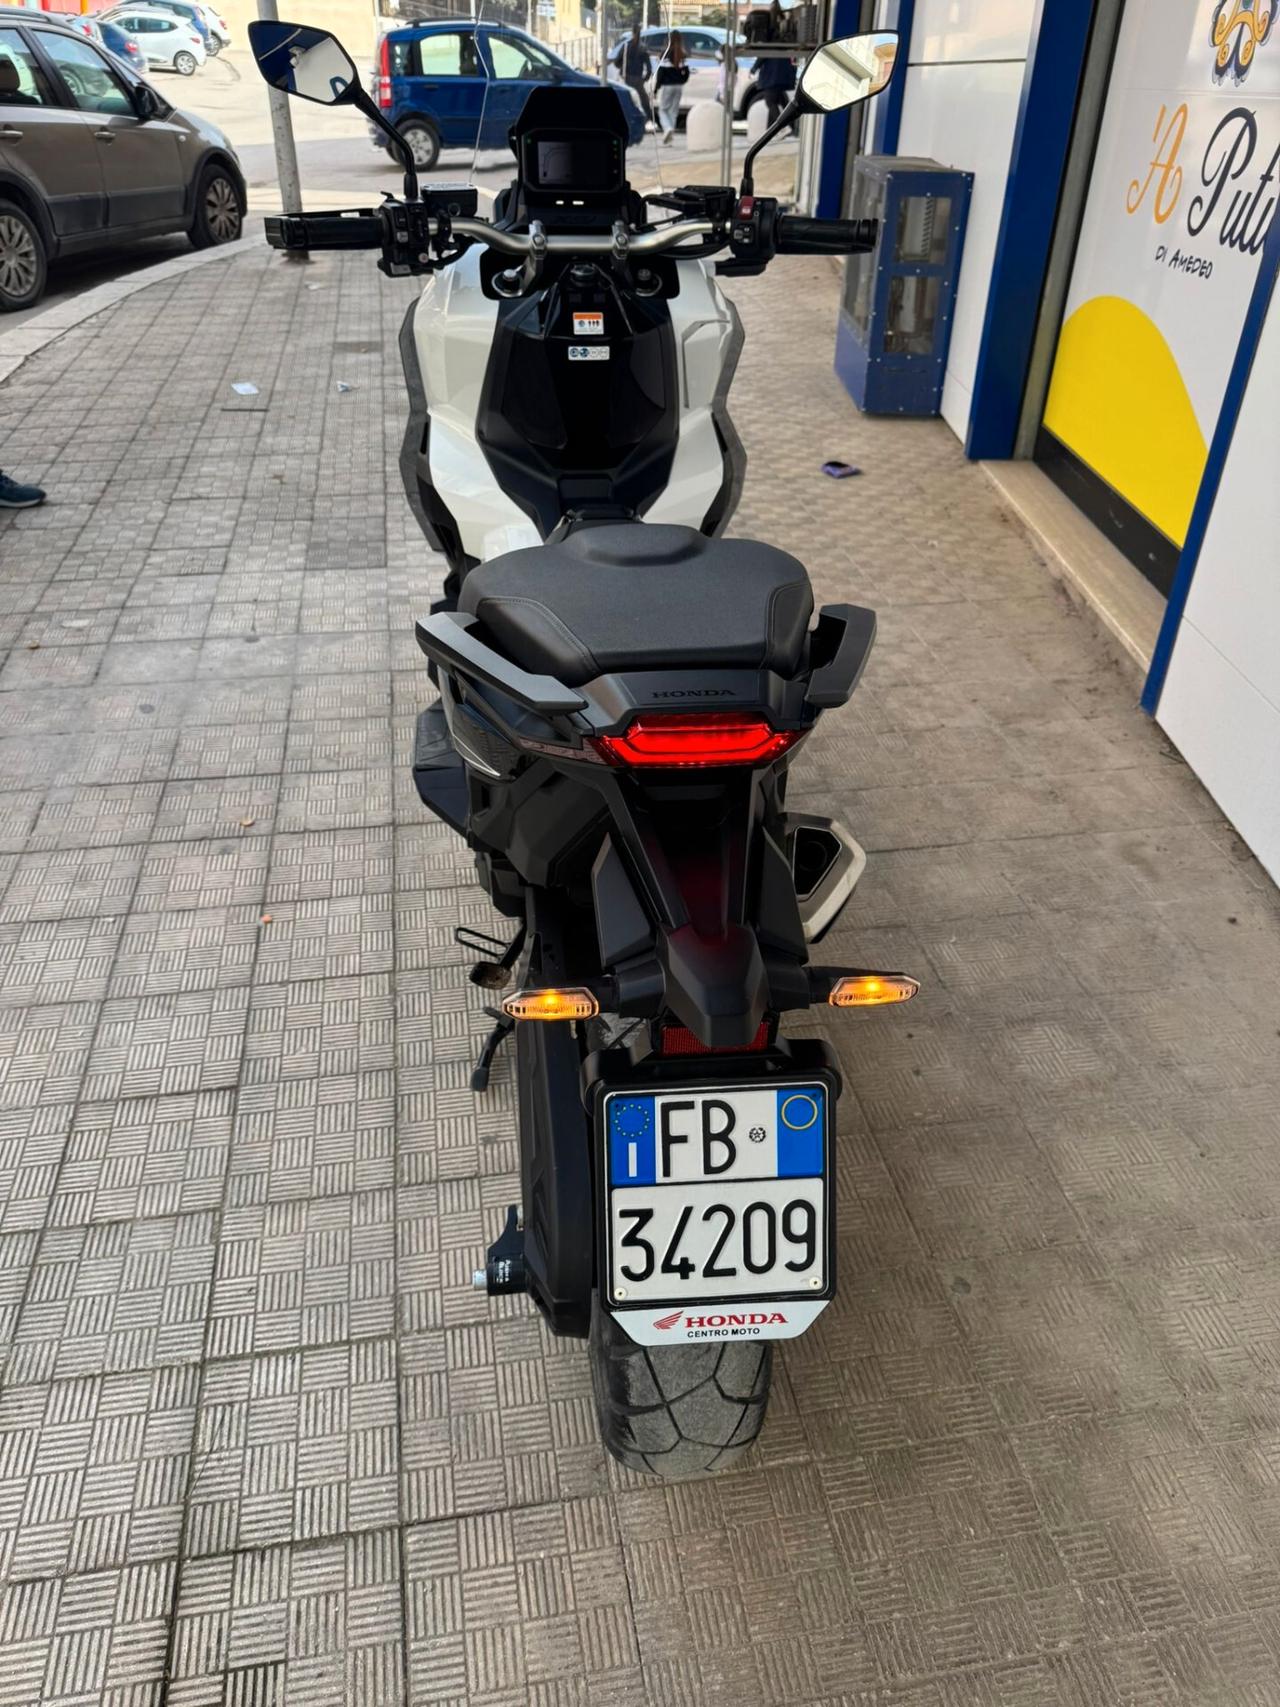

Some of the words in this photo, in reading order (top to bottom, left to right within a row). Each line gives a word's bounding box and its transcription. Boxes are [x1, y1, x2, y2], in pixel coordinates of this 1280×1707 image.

[1155, 246, 1167, 261] DI
[1169, 249, 1212, 279] AMEDEO
[652, 690, 736, 698] HONDA
[660, 1100, 736, 1177] FB
[619, 1199, 816, 1281] 34209
[685, 1313, 787, 1327] HONDA
[687, 1329, 729, 1338] CENTRO
[731, 1327, 760, 1336] MOTO
